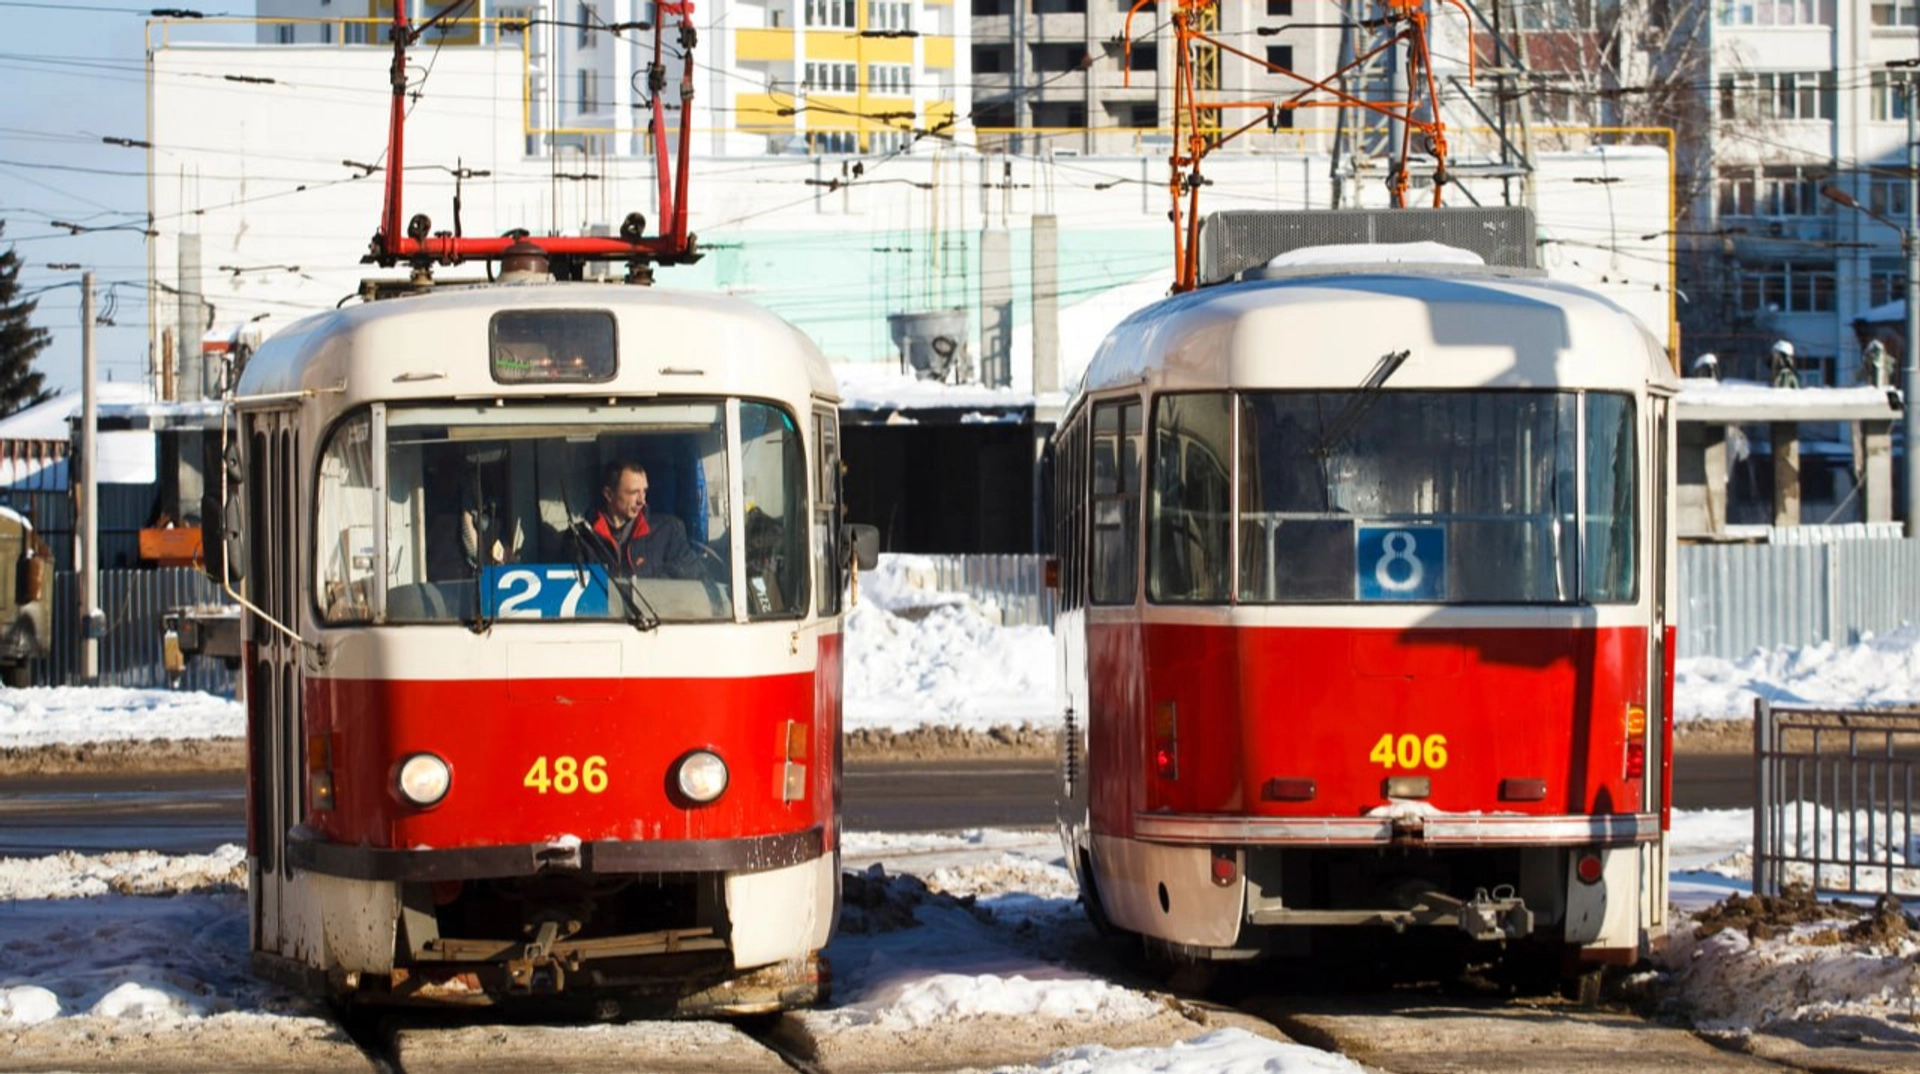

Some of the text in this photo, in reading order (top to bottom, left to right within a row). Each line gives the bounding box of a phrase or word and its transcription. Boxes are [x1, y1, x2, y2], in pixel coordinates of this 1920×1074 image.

[1375, 531, 1423, 592] 8
[498, 569, 591, 619] 27
[1369, 733, 1448, 769] 406
[523, 755, 608, 794] 486
